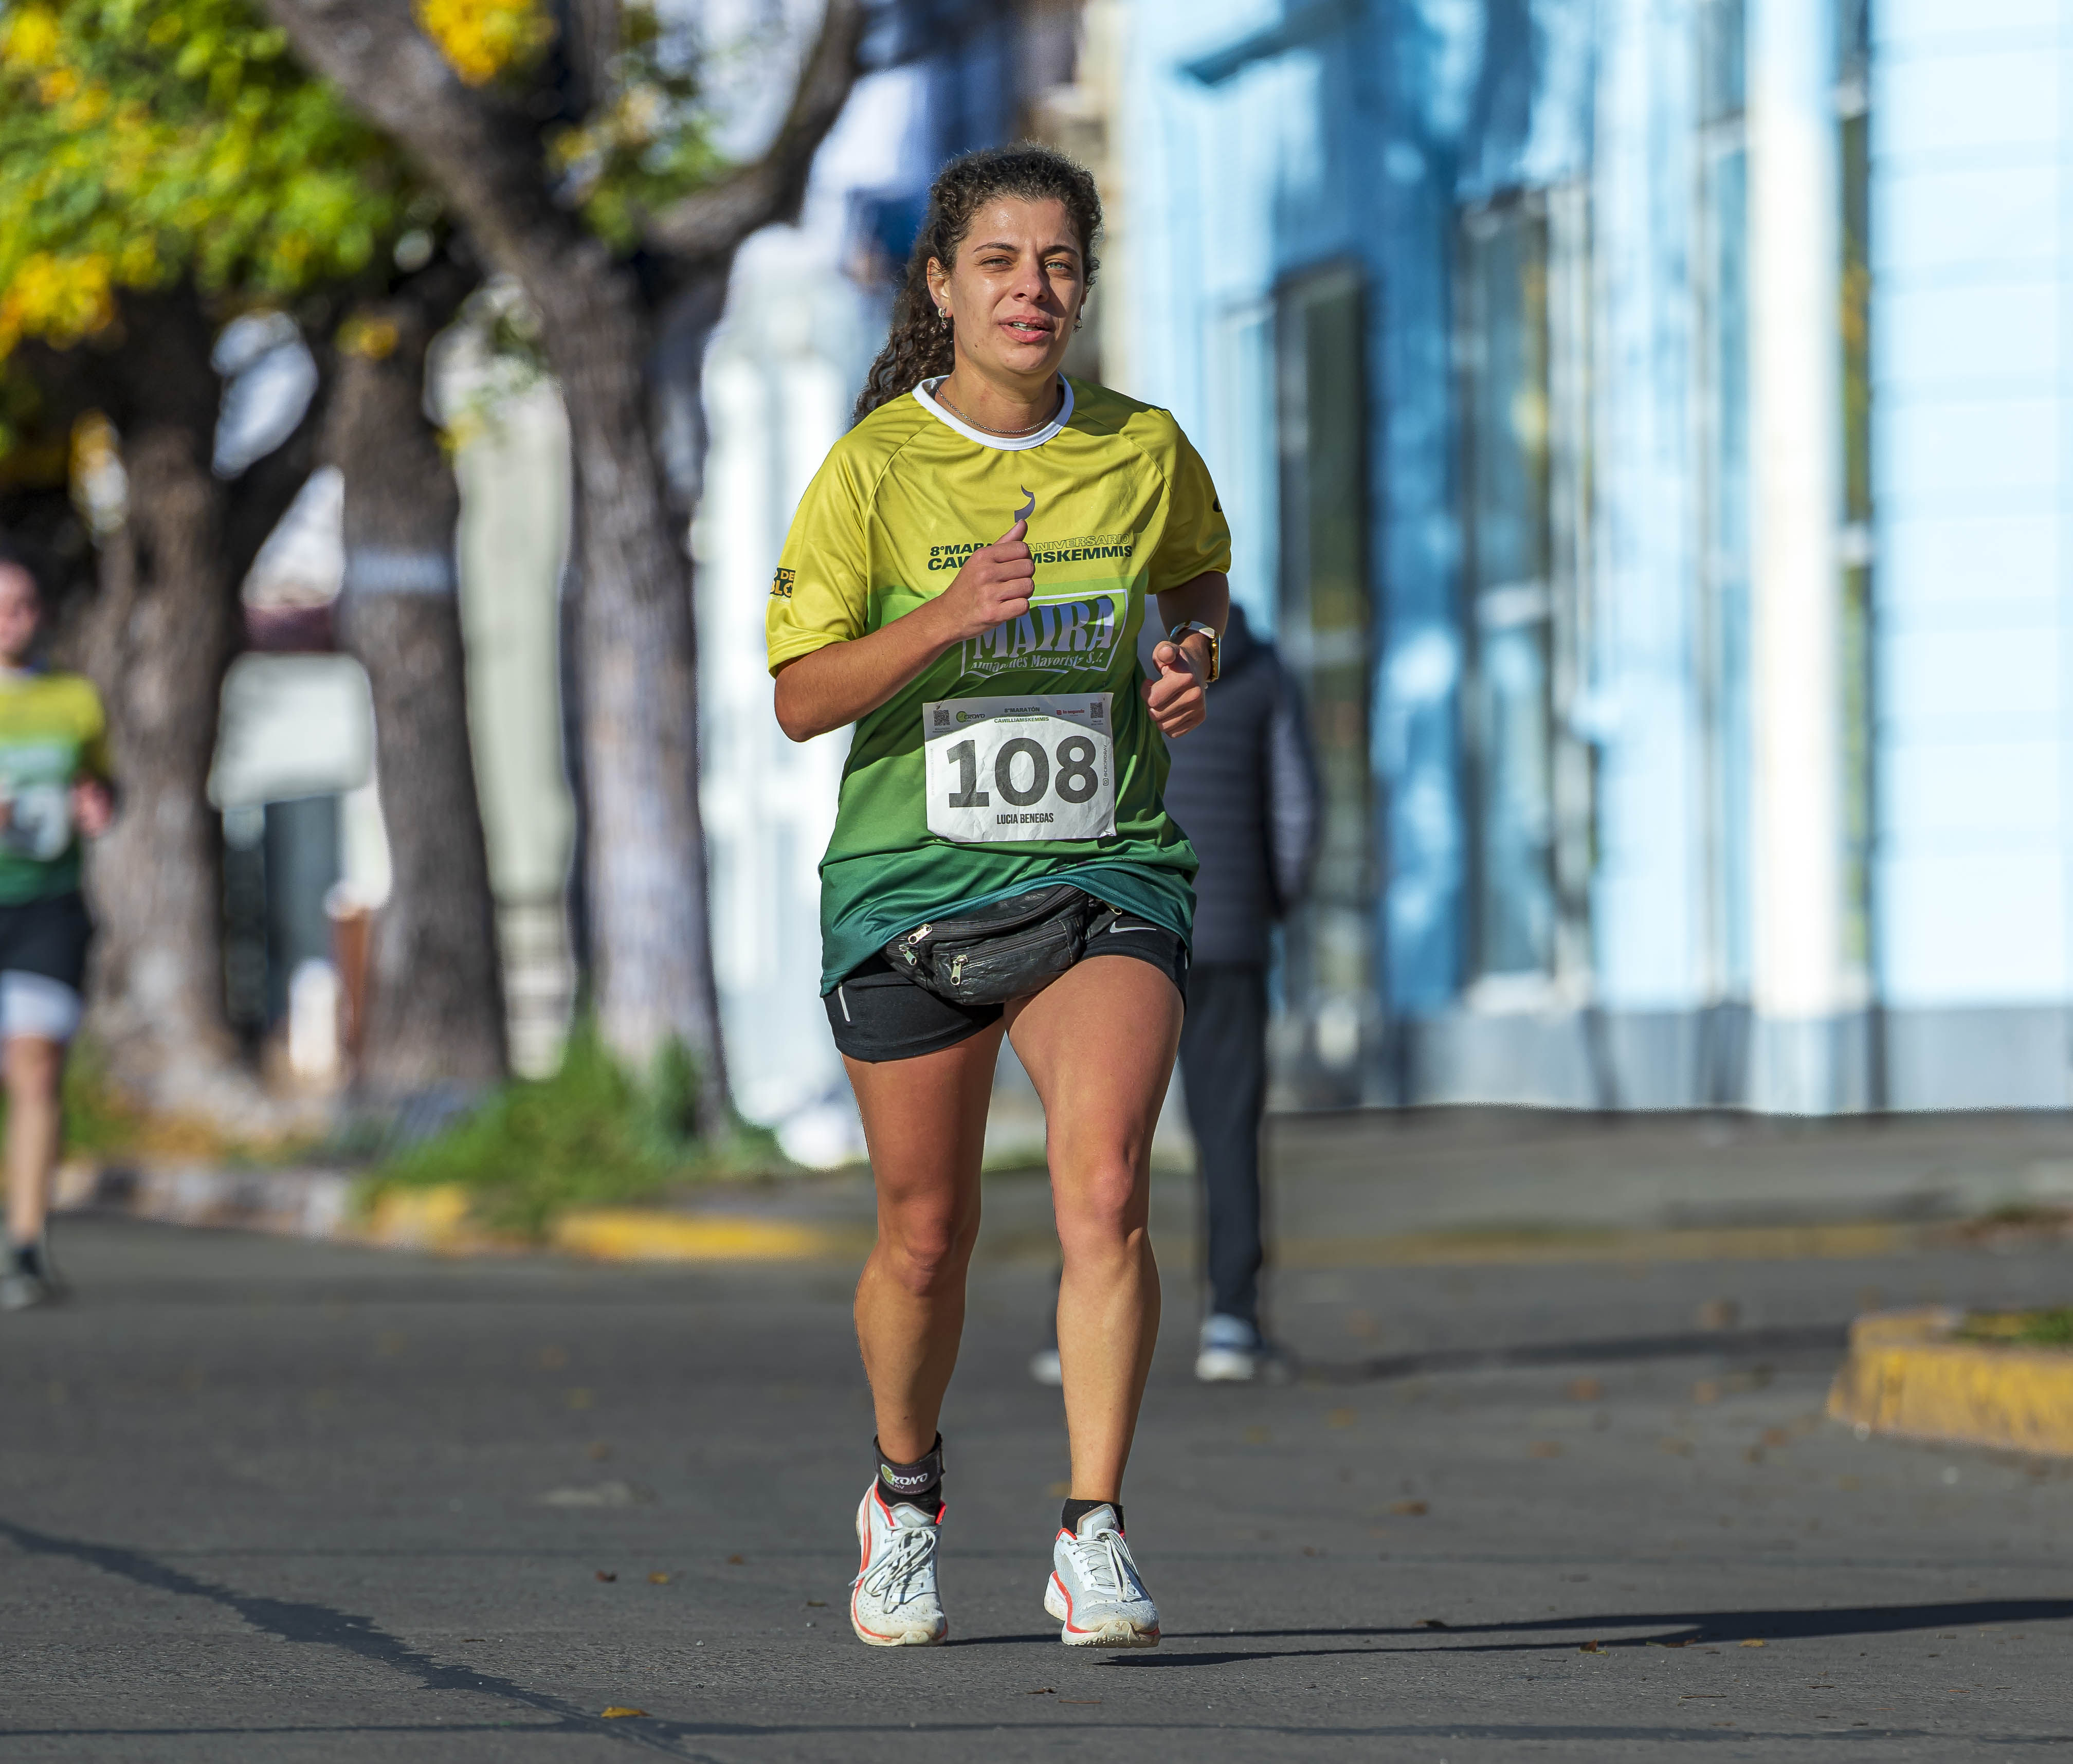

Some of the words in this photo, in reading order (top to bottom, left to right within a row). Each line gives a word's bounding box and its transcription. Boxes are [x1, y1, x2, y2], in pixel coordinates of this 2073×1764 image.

[930, 542, 992, 556] 8°MAR
[1028, 534, 1130, 552] ANIVERSARIO
[973, 598, 1114, 659] MAIRA
[947, 735, 1099, 808] 108
[996, 814, 1019, 825] LUCIA
[1020, 812, 1054, 824] BENEGAS
